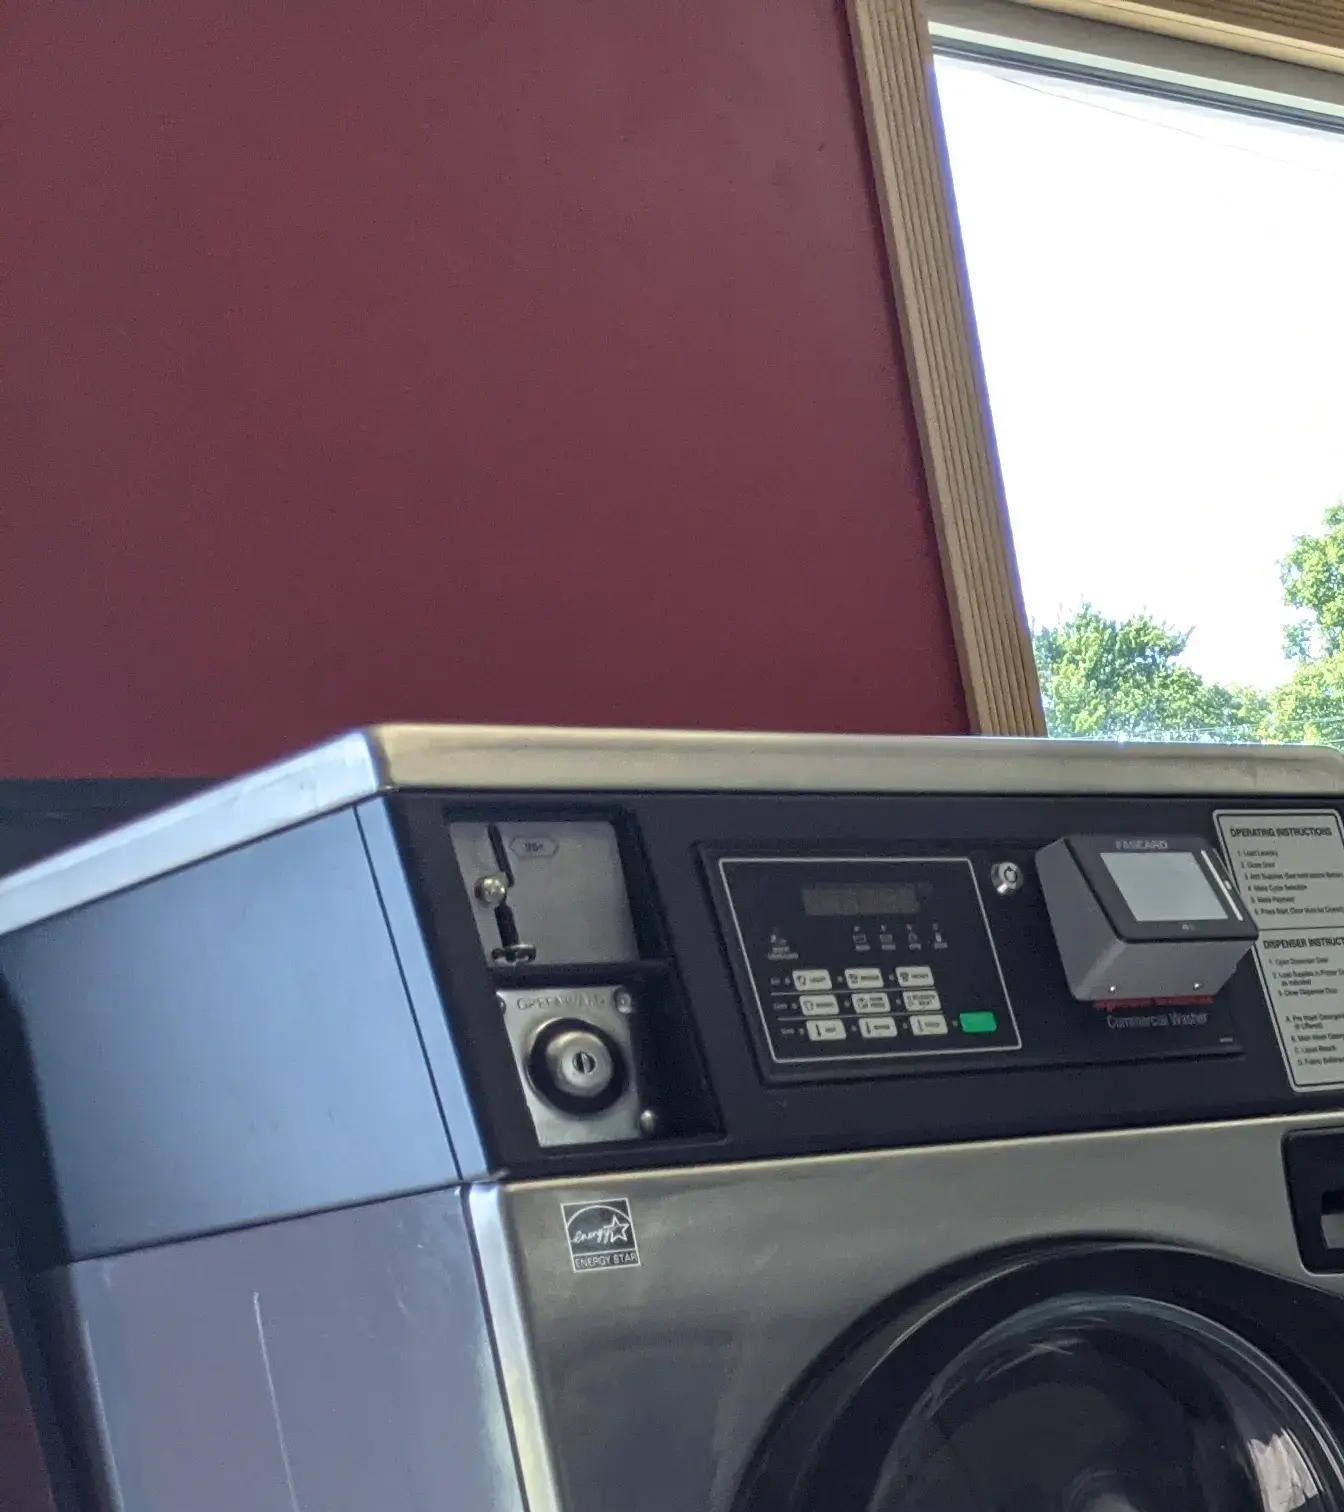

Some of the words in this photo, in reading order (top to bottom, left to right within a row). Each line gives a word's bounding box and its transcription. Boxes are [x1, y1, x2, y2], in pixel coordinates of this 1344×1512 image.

[1230, 827, 1275, 837] OPERATING
[1276, 826, 1332, 837] INSTRUCTIONS
[1263, 938, 1308, 949] DISPENSER
[1107, 1014, 1168, 1029] Commercial
[1169, 1010, 1208, 1025] Washer
[575, 1255, 611, 1268] ENERGY
[613, 1252, 637, 1264] STAR
